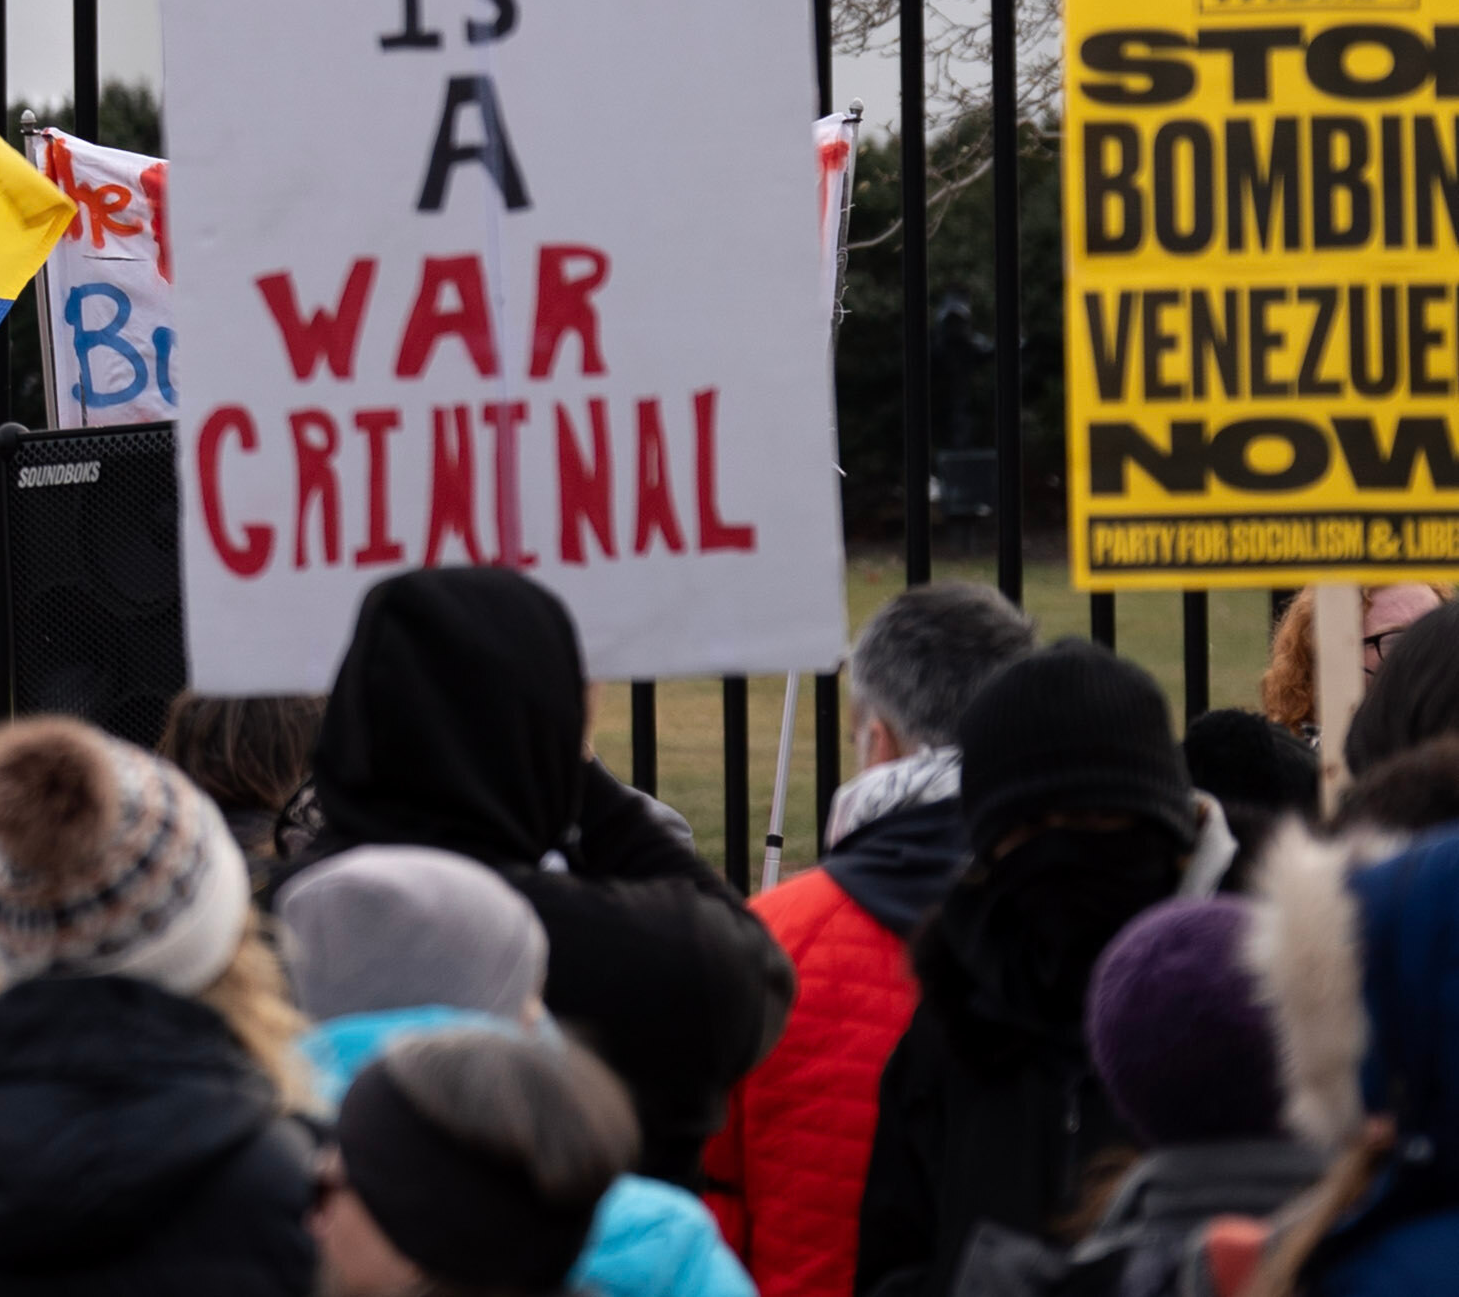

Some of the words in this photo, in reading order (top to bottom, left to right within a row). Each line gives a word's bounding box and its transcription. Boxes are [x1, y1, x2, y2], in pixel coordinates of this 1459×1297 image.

[1079, 22, 1459, 108] STO
[415, 74, 534, 214] A
[254, 243, 611, 383] WAR
[18, 461, 102, 489] SOUNDBOKS
[197, 385, 756, 582] CRIMINAL
[1093, 521, 1182, 566] PARTY
[1183, 520, 1230, 564] FOR
[1231, 517, 1364, 561] SOCIALISM
[1367, 517, 1401, 560] &
